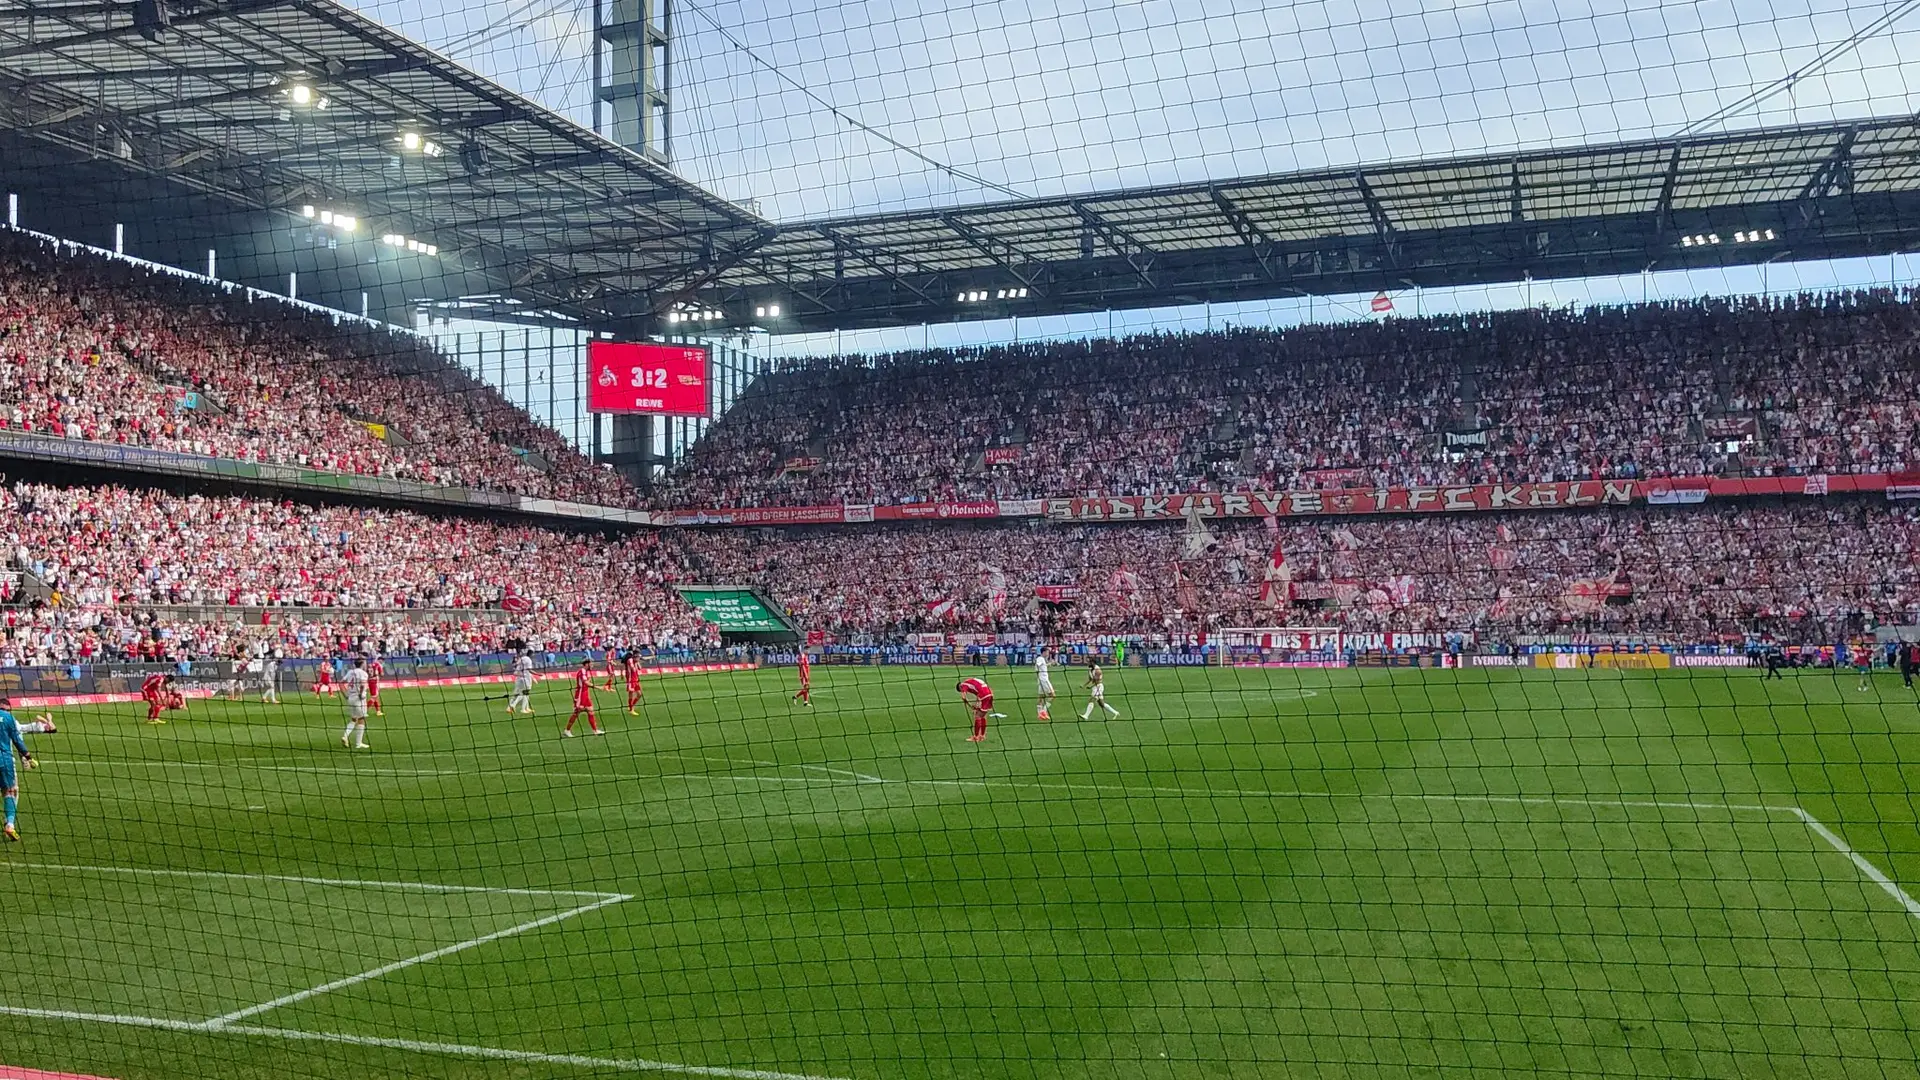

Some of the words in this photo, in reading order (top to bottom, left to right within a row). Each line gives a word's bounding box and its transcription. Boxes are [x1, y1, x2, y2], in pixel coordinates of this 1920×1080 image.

[631, 366, 667, 389] 3:2
[635, 398, 664, 408] REWE
[36, 440, 75, 454] SACHEN
[1047, 493, 1323, 518] SÜDKURVE
[1489, 482, 1633, 507] KÖLN
[951, 504, 995, 516] Holweide
[1271, 633, 1301, 648] DES
[767, 654, 817, 664] MERKR
[887, 653, 938, 663] MERKUR
[1147, 653, 1205, 664] MERKUR
